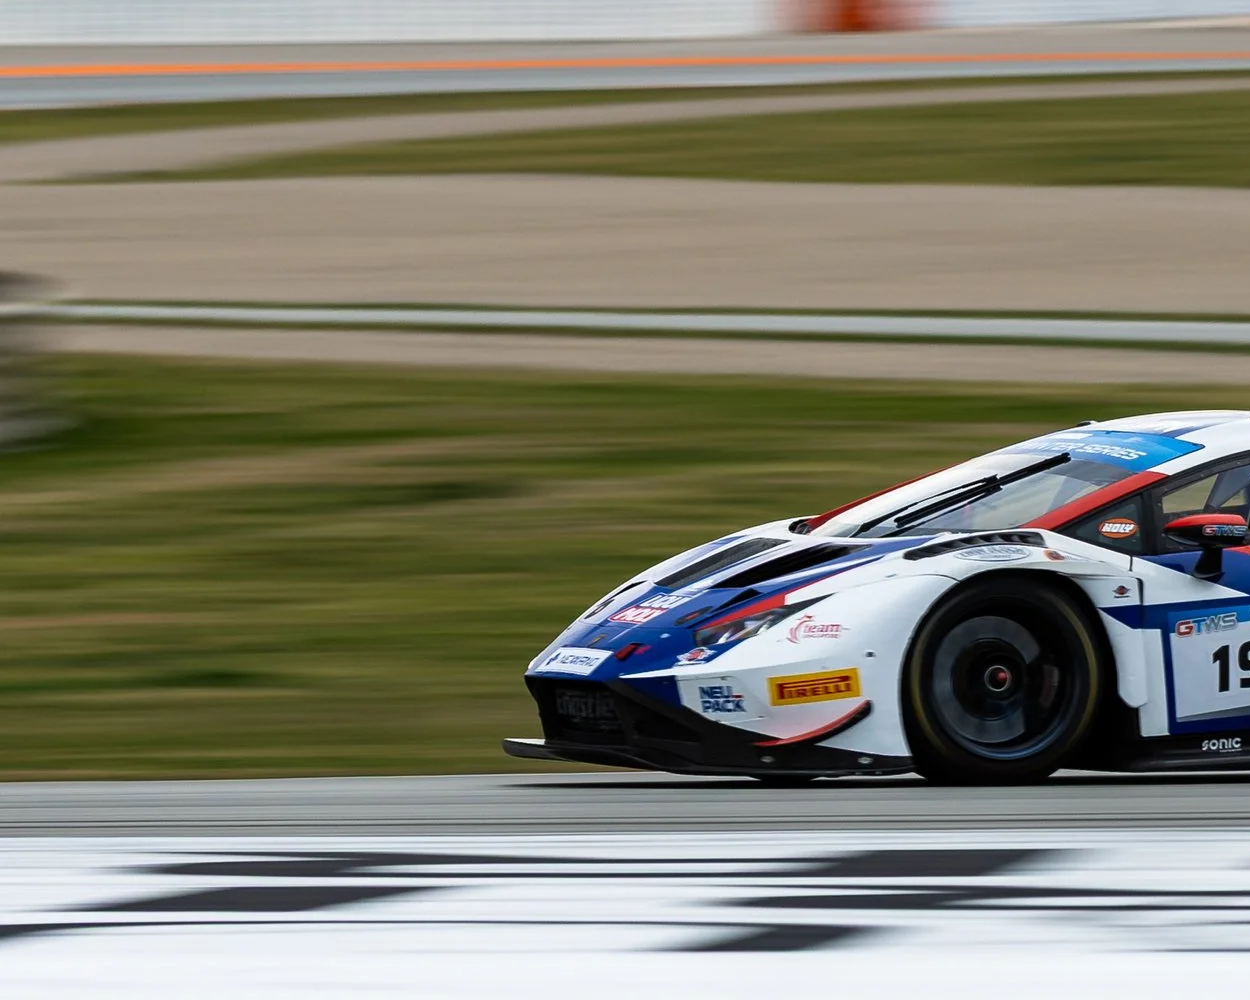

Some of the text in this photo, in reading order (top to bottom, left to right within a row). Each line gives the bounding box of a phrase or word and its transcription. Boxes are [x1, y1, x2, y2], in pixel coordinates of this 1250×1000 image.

[1077, 443, 1147, 460] SERIES
[1202, 524, 1249, 537] GTWS
[1175, 612, 1238, 638] GTWS
[699, 686, 733, 698] NEU
[777, 675, 852, 700] PIRELLI
[701, 700, 747, 712] PACK
